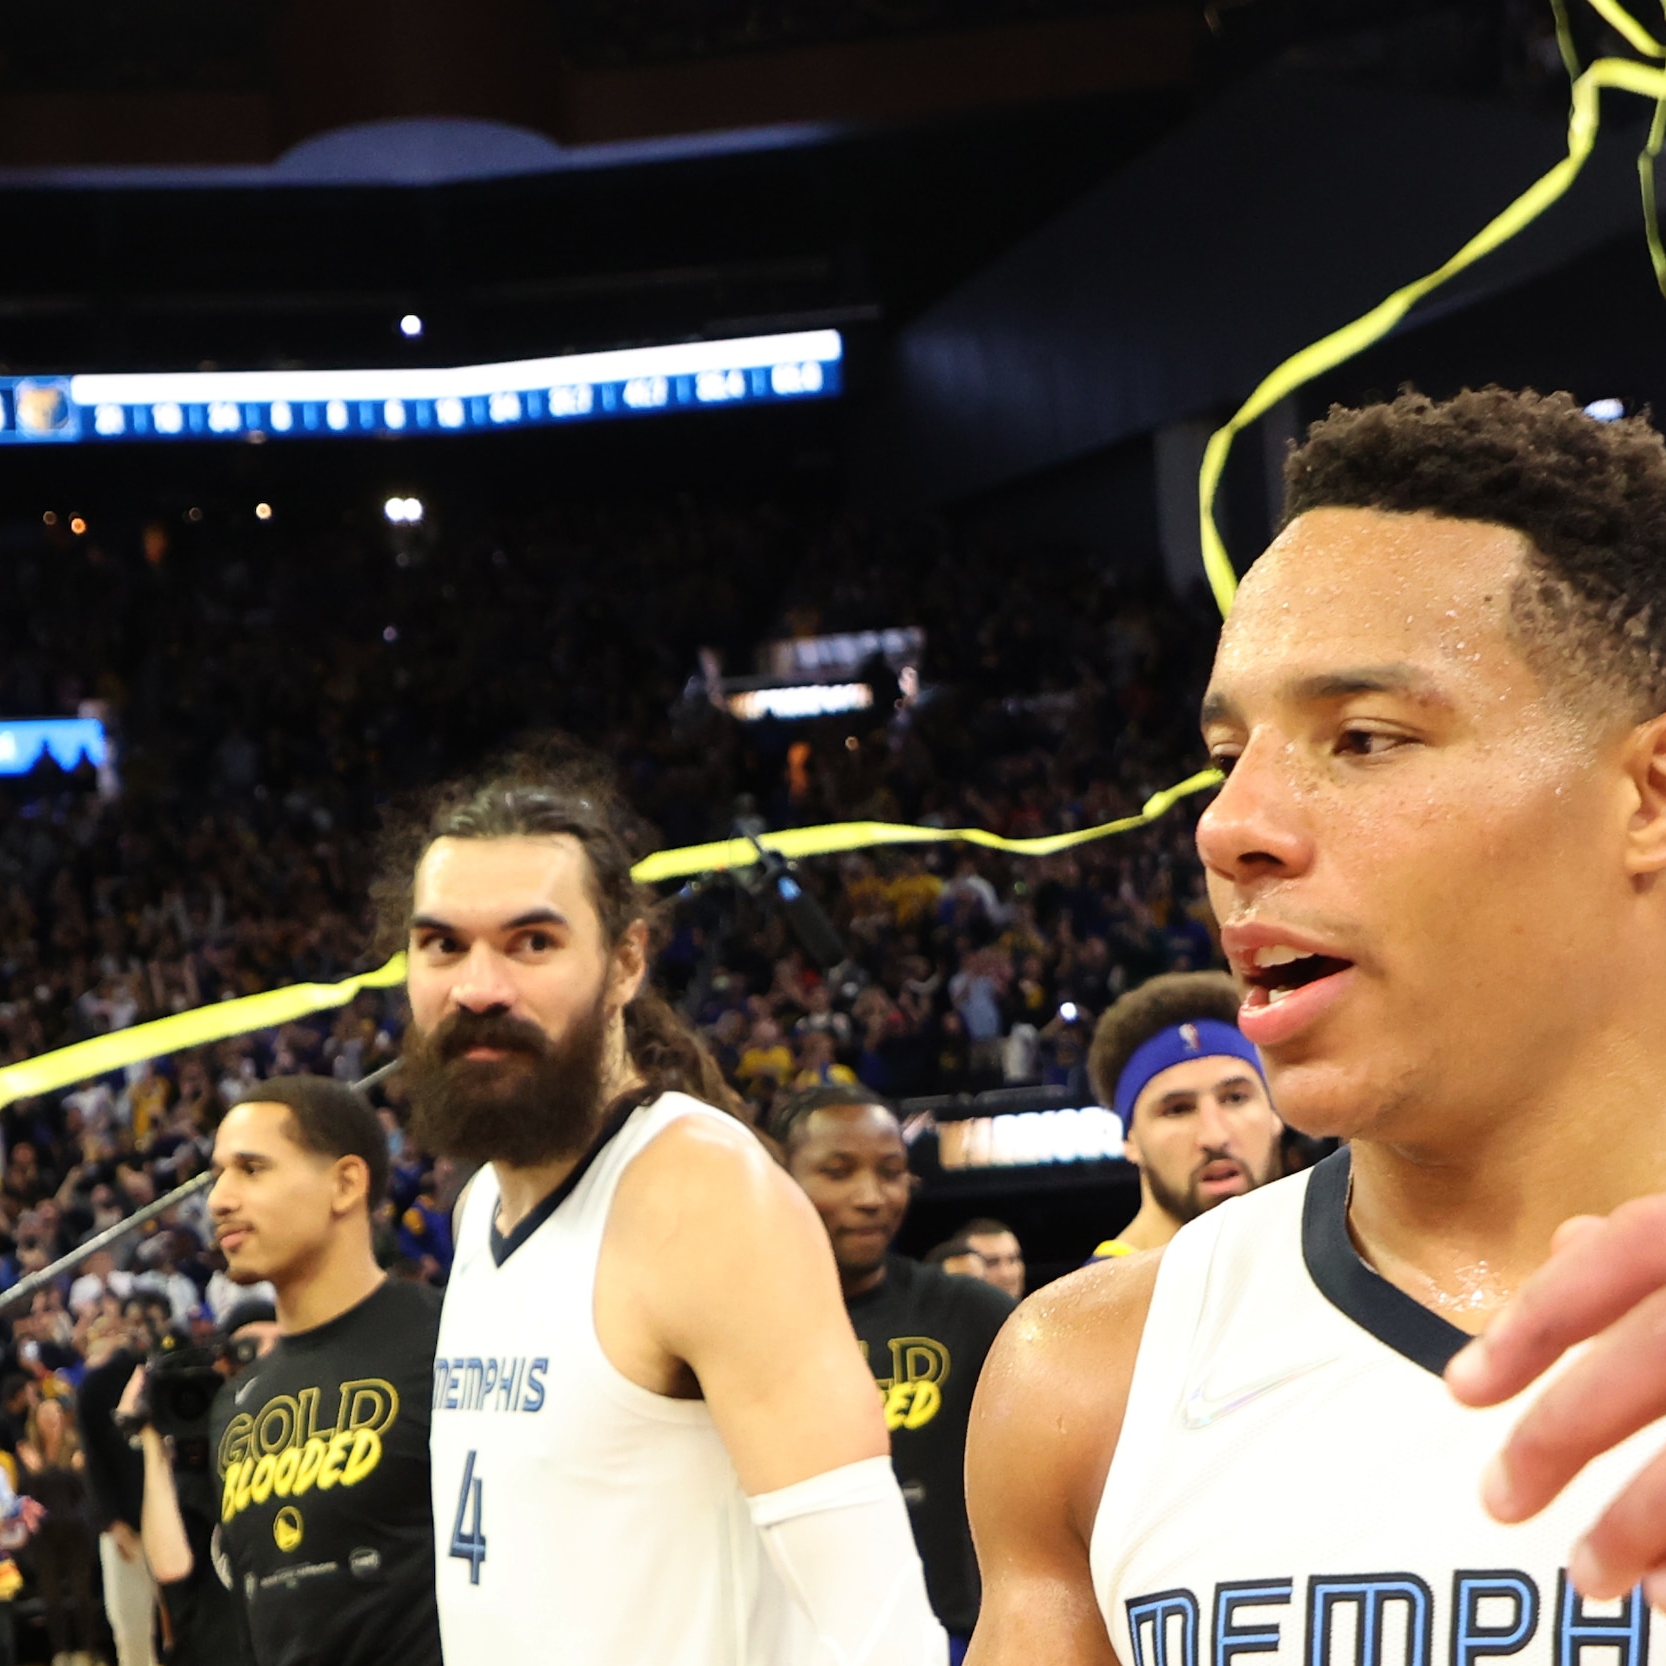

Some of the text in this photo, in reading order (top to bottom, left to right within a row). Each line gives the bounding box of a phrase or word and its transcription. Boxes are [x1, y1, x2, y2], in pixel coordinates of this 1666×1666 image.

[218, 1377, 400, 1468] GOLD
[432, 1357, 549, 1413] MEMPHIS
[221, 1428, 383, 1524] BLOODED
[448, 1449, 487, 1586] 4
